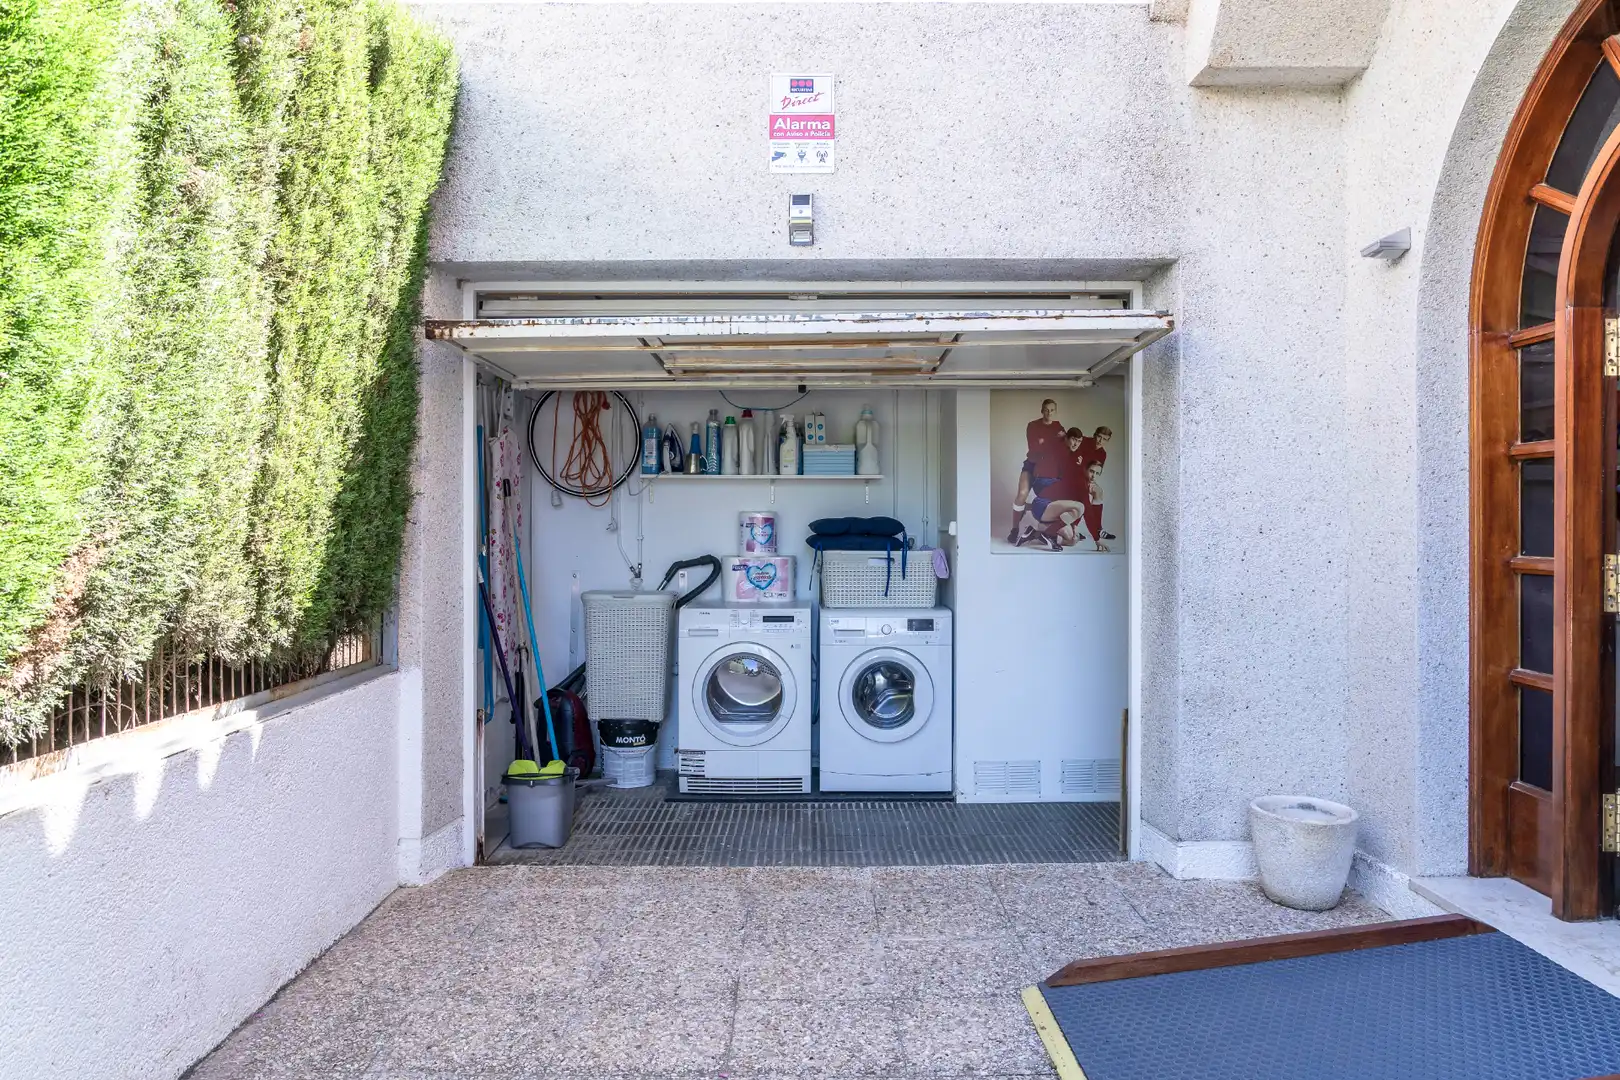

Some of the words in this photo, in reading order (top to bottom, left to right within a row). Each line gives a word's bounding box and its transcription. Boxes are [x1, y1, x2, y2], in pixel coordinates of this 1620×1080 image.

[781, 92, 824, 110] Direct
[773, 117, 831, 130] Alarma
[616, 734, 646, 744] MONTÓ
